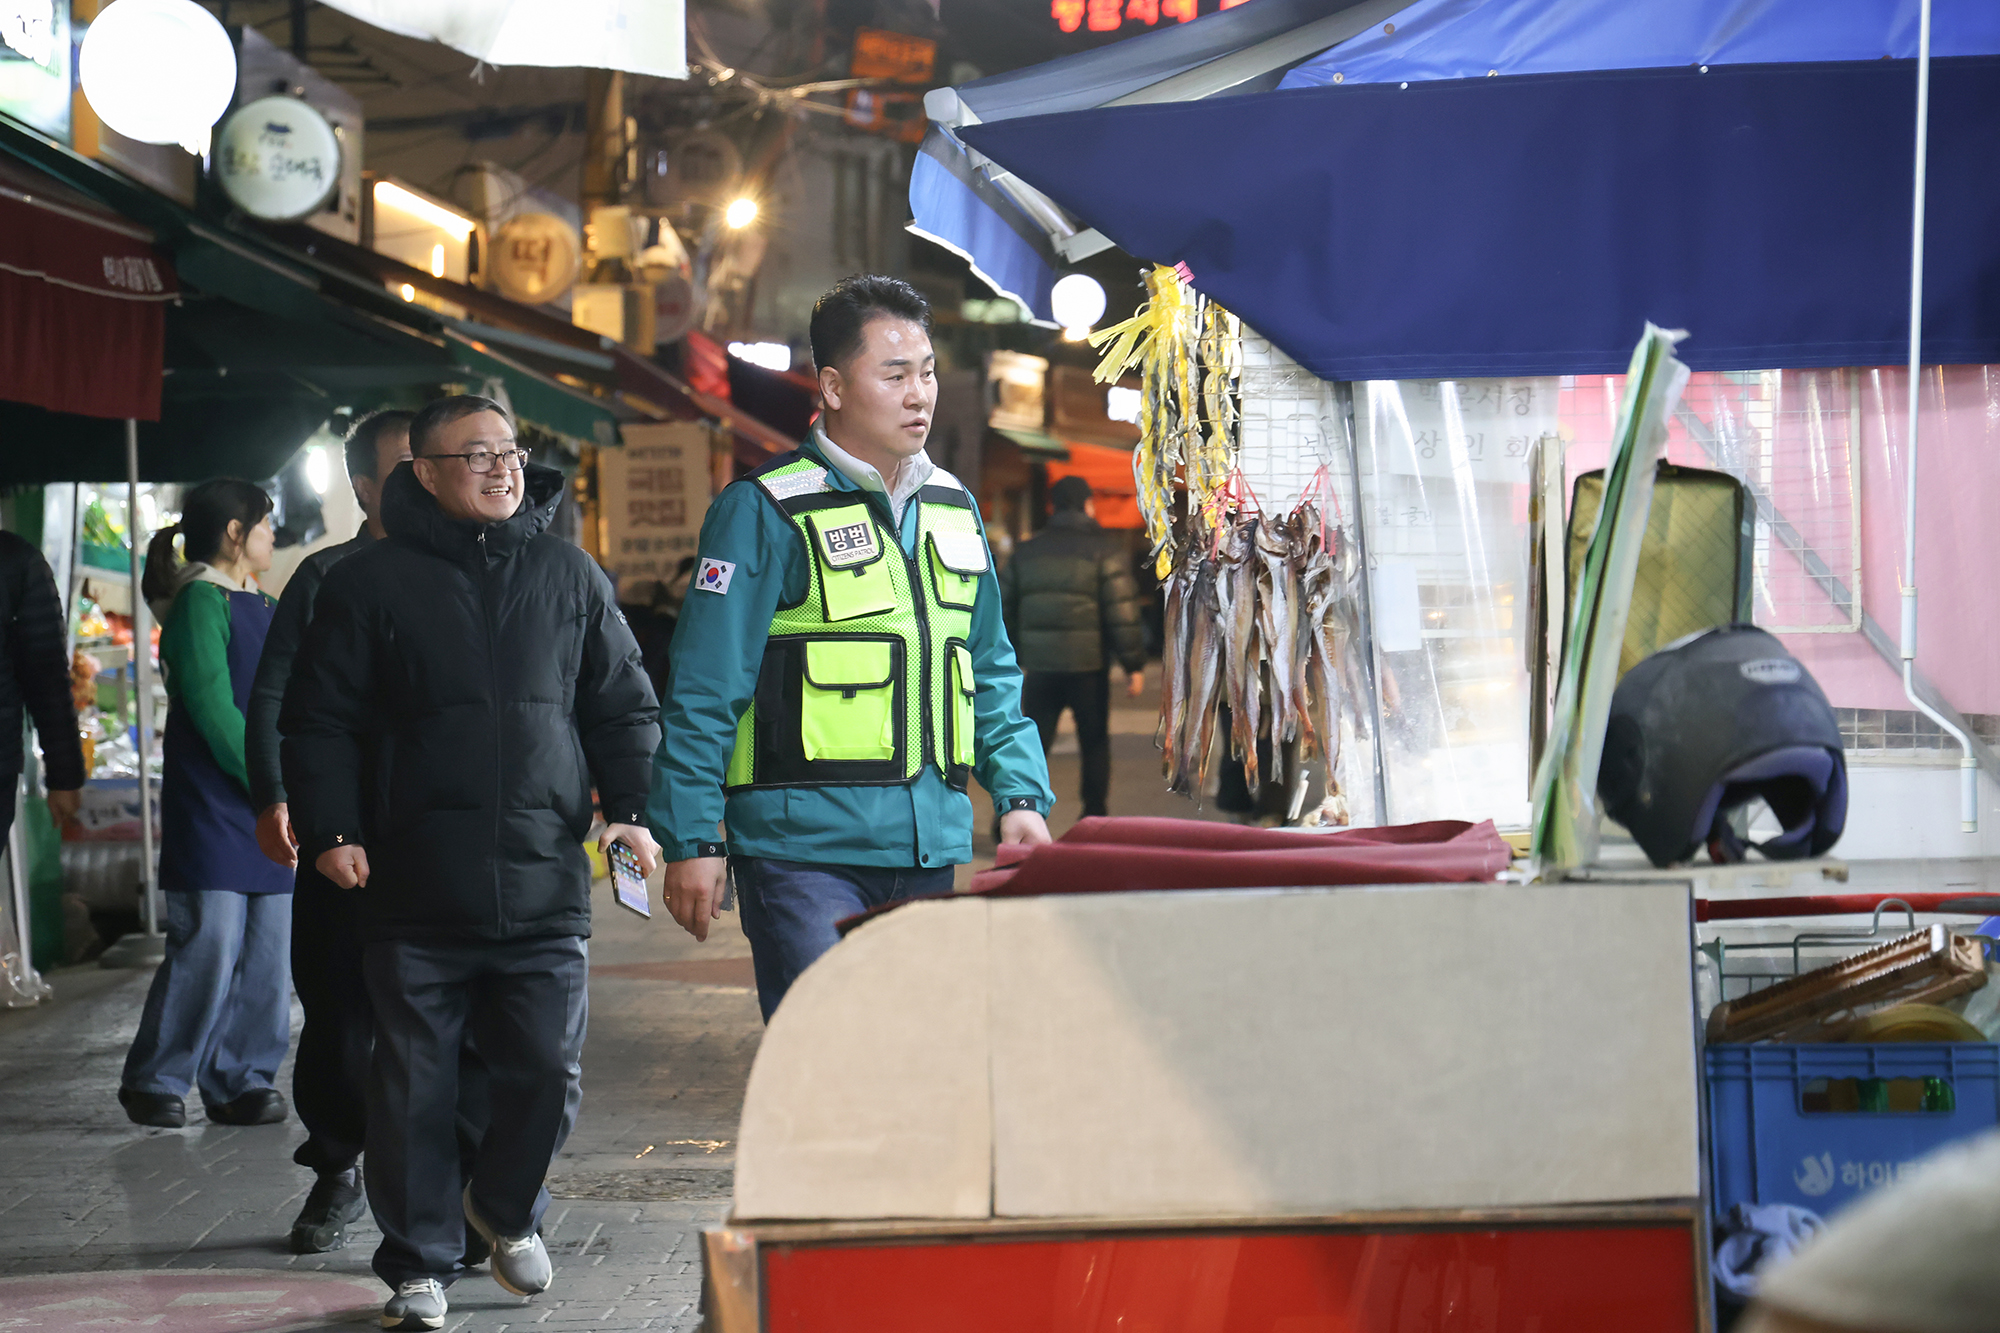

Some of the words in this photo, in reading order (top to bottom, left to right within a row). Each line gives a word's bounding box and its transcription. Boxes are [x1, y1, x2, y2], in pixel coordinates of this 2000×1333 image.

[829, 525, 868, 551] 방범
[832, 552, 855, 562] CITIZENS
[856, 548, 875, 556] PATROL
